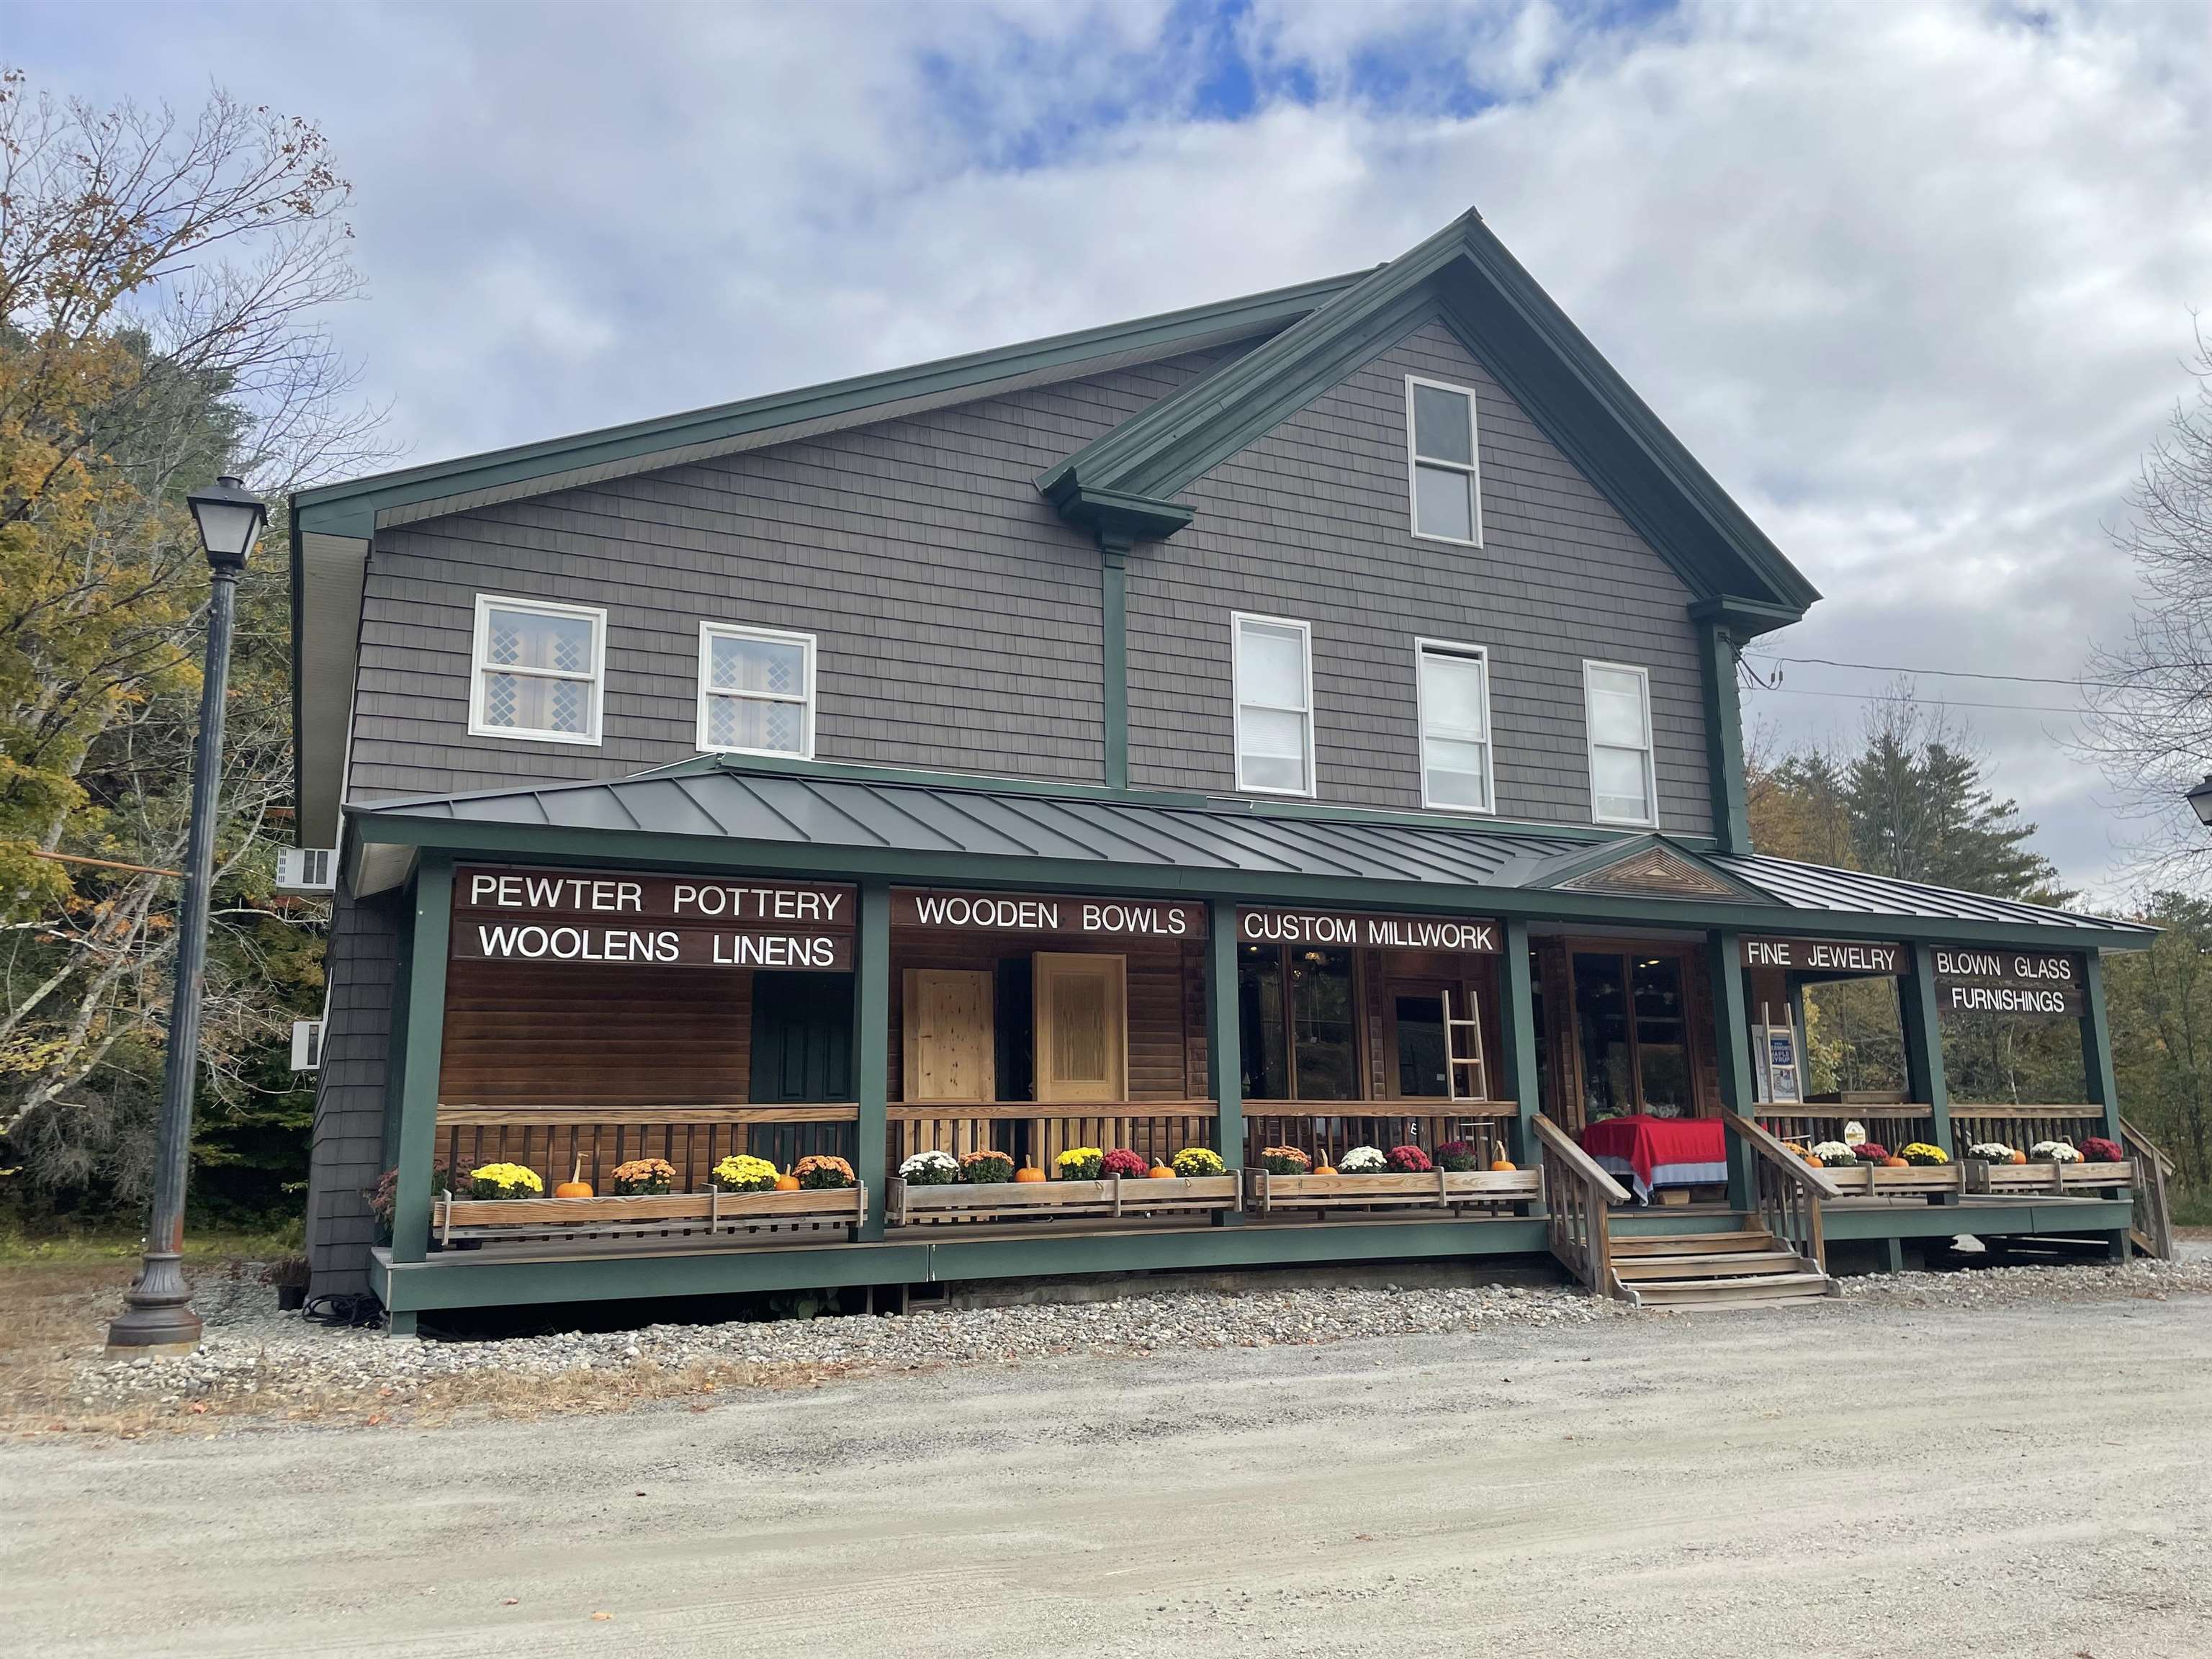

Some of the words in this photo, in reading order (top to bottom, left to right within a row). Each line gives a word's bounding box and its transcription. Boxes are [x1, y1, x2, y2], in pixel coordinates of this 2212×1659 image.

[471, 875, 642, 912] PEWTER
[673, 885, 842, 920] POTTERY
[915, 897, 1058, 929] WOODEN
[1083, 904, 1186, 935] BOWLS
[478, 925, 679, 962] WOOLENS
[713, 935, 834, 966] LINENS
[1244, 912, 1357, 943] CUSTOM
[1368, 920, 1493, 950] MILLWORK
[1748, 942, 1791, 966] FINE
[1807, 945, 1895, 971] JEWELRY
[1937, 953, 2001, 976] BLOWN
[2014, 957, 2071, 980] GLASS
[1951, 987, 2064, 1013] FURNISHINGS
